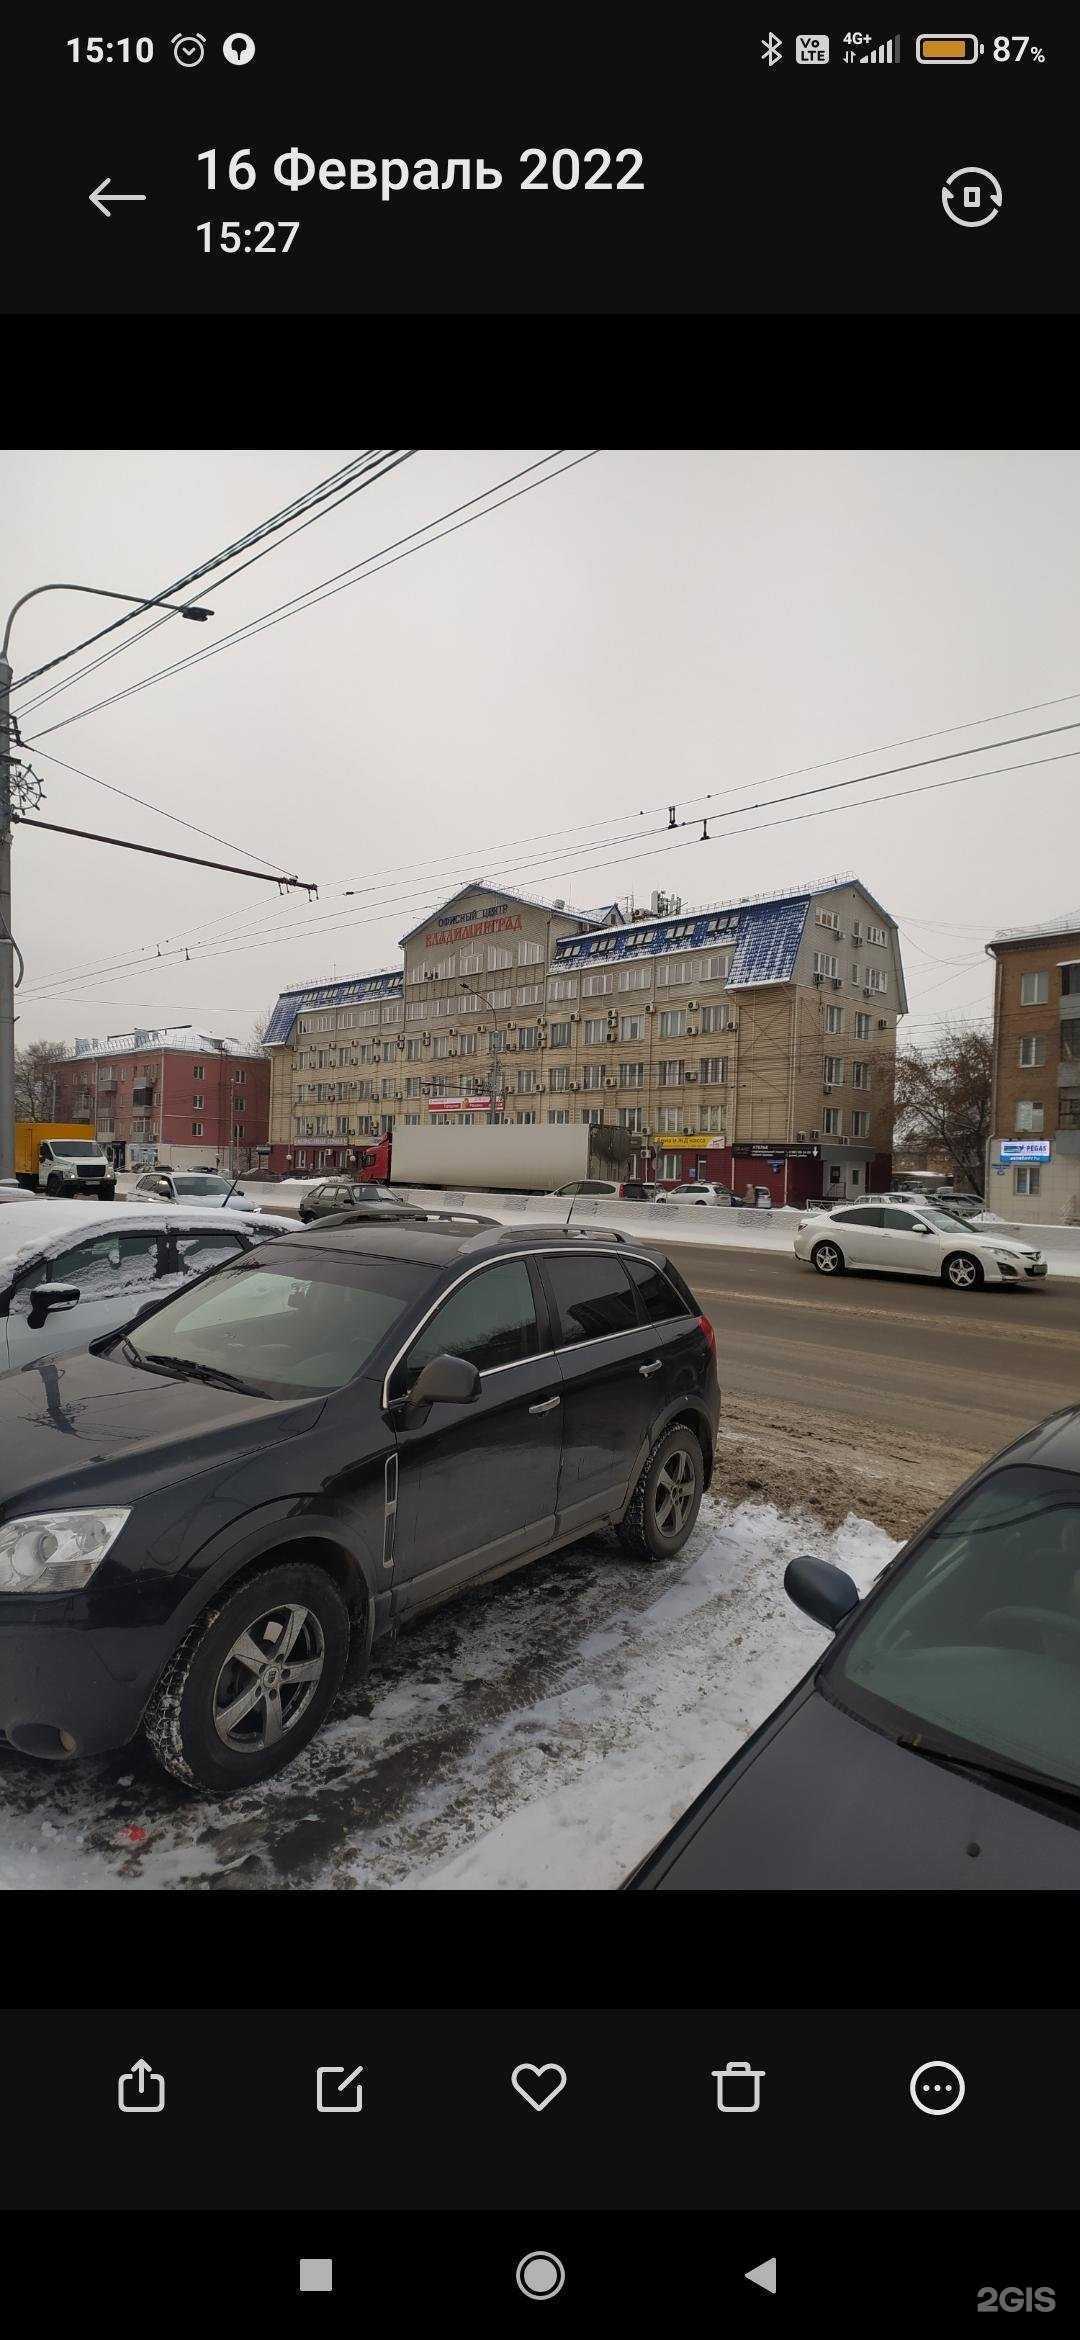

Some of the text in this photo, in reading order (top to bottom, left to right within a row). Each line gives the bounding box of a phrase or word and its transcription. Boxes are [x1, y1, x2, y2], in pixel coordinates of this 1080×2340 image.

[800, 38, 820, 48] Vo
[843, 32, 872, 45] 4G+
[68, 37, 154, 63] 15:10
[801, 50, 826, 62] LTE
[198, 147, 645, 200] 16 Февраль 2022
[197, 221, 300, 253] 15:27
